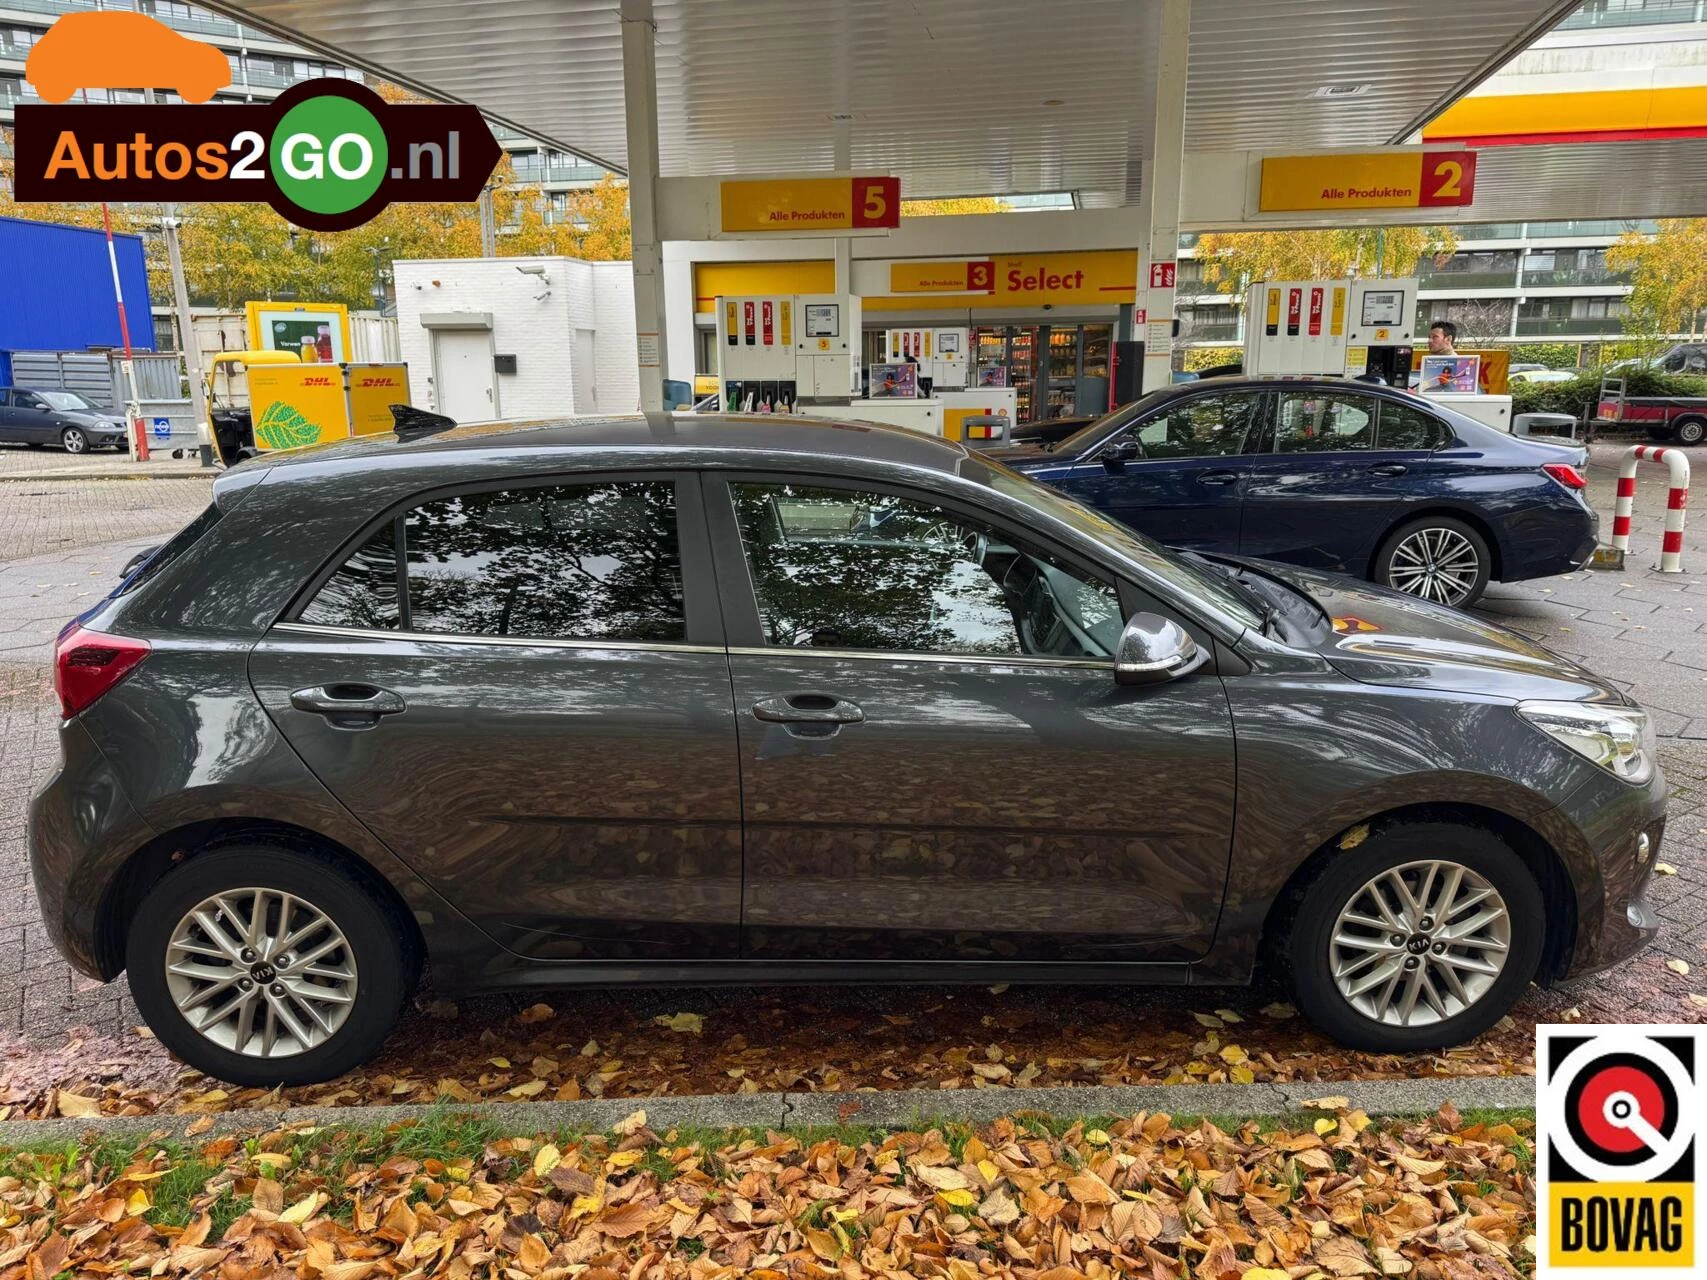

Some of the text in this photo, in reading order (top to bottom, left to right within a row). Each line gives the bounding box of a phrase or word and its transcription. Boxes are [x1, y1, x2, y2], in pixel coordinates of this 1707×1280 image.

[1321, 160, 1463, 199] Alle Produkten 2
[769, 185, 887, 221] Alle Produkten 5
[973, 266, 988, 286] 3
[1007, 267, 1085, 291] Select
[304, 377, 331, 386] DHL
[362, 378, 395, 387] DHL
[1409, 938, 1429, 951] KIA
[252, 966, 274, 980] KIA
